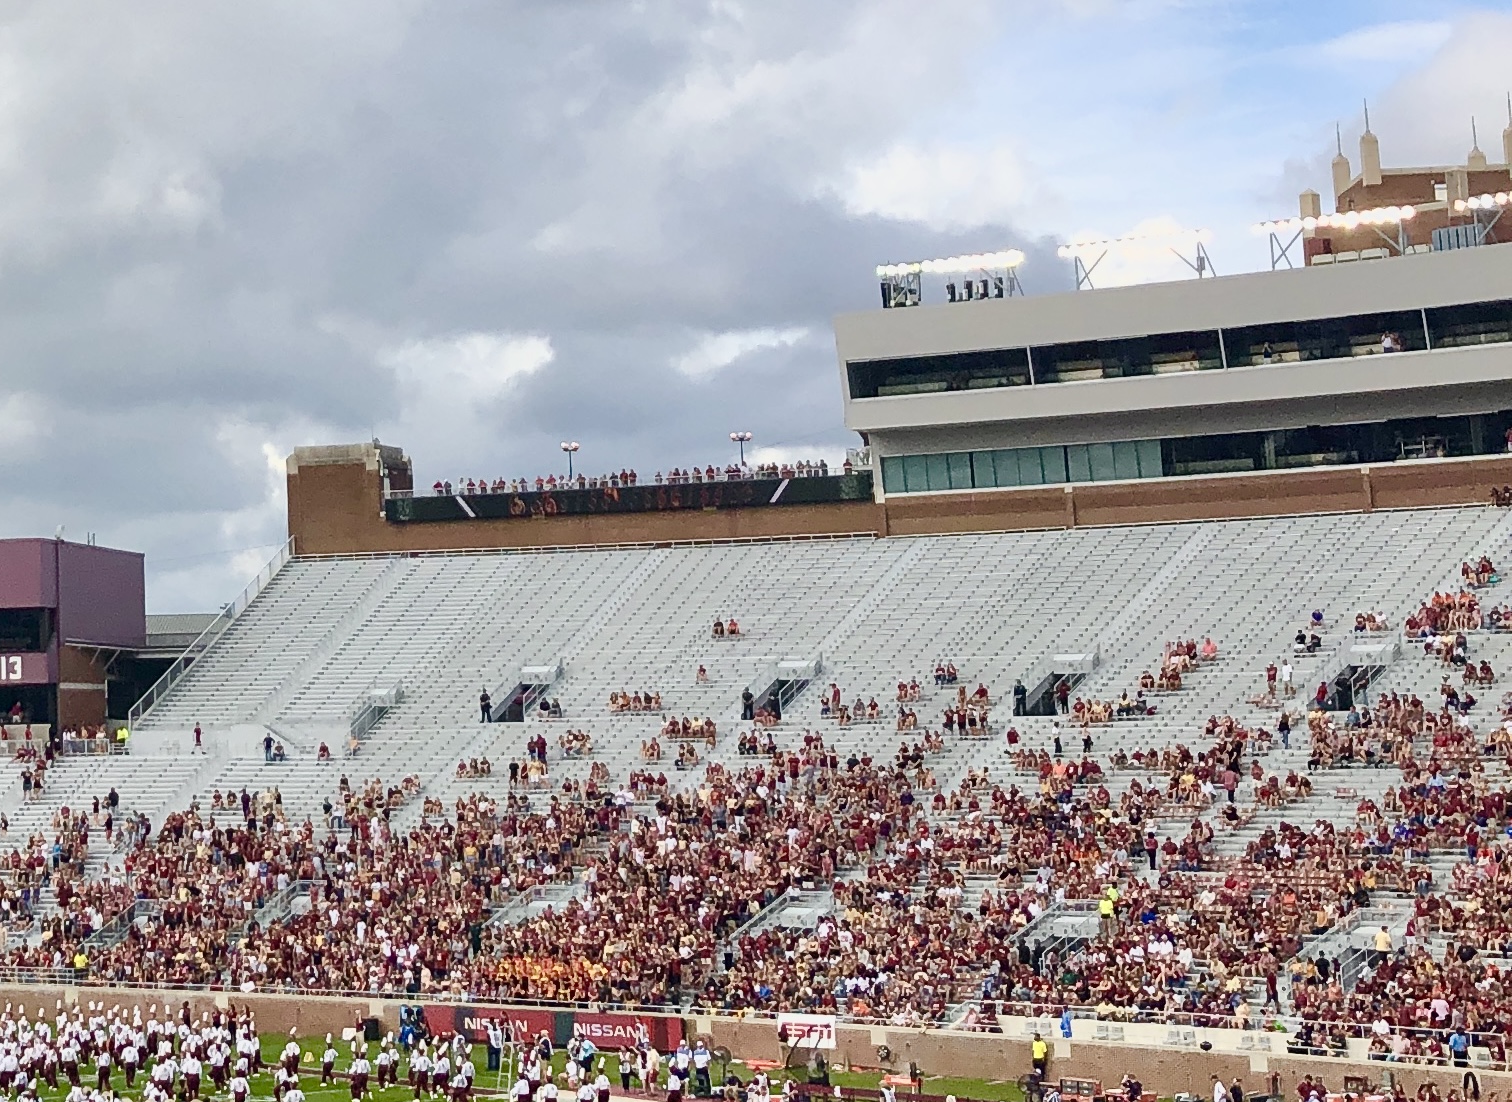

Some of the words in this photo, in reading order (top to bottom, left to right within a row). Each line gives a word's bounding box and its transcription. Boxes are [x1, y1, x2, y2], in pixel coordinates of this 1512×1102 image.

[464, 1017, 528, 1033] NISN
[573, 1022, 640, 1039] NISSAN
[781, 1022, 832, 1039] ESPN
